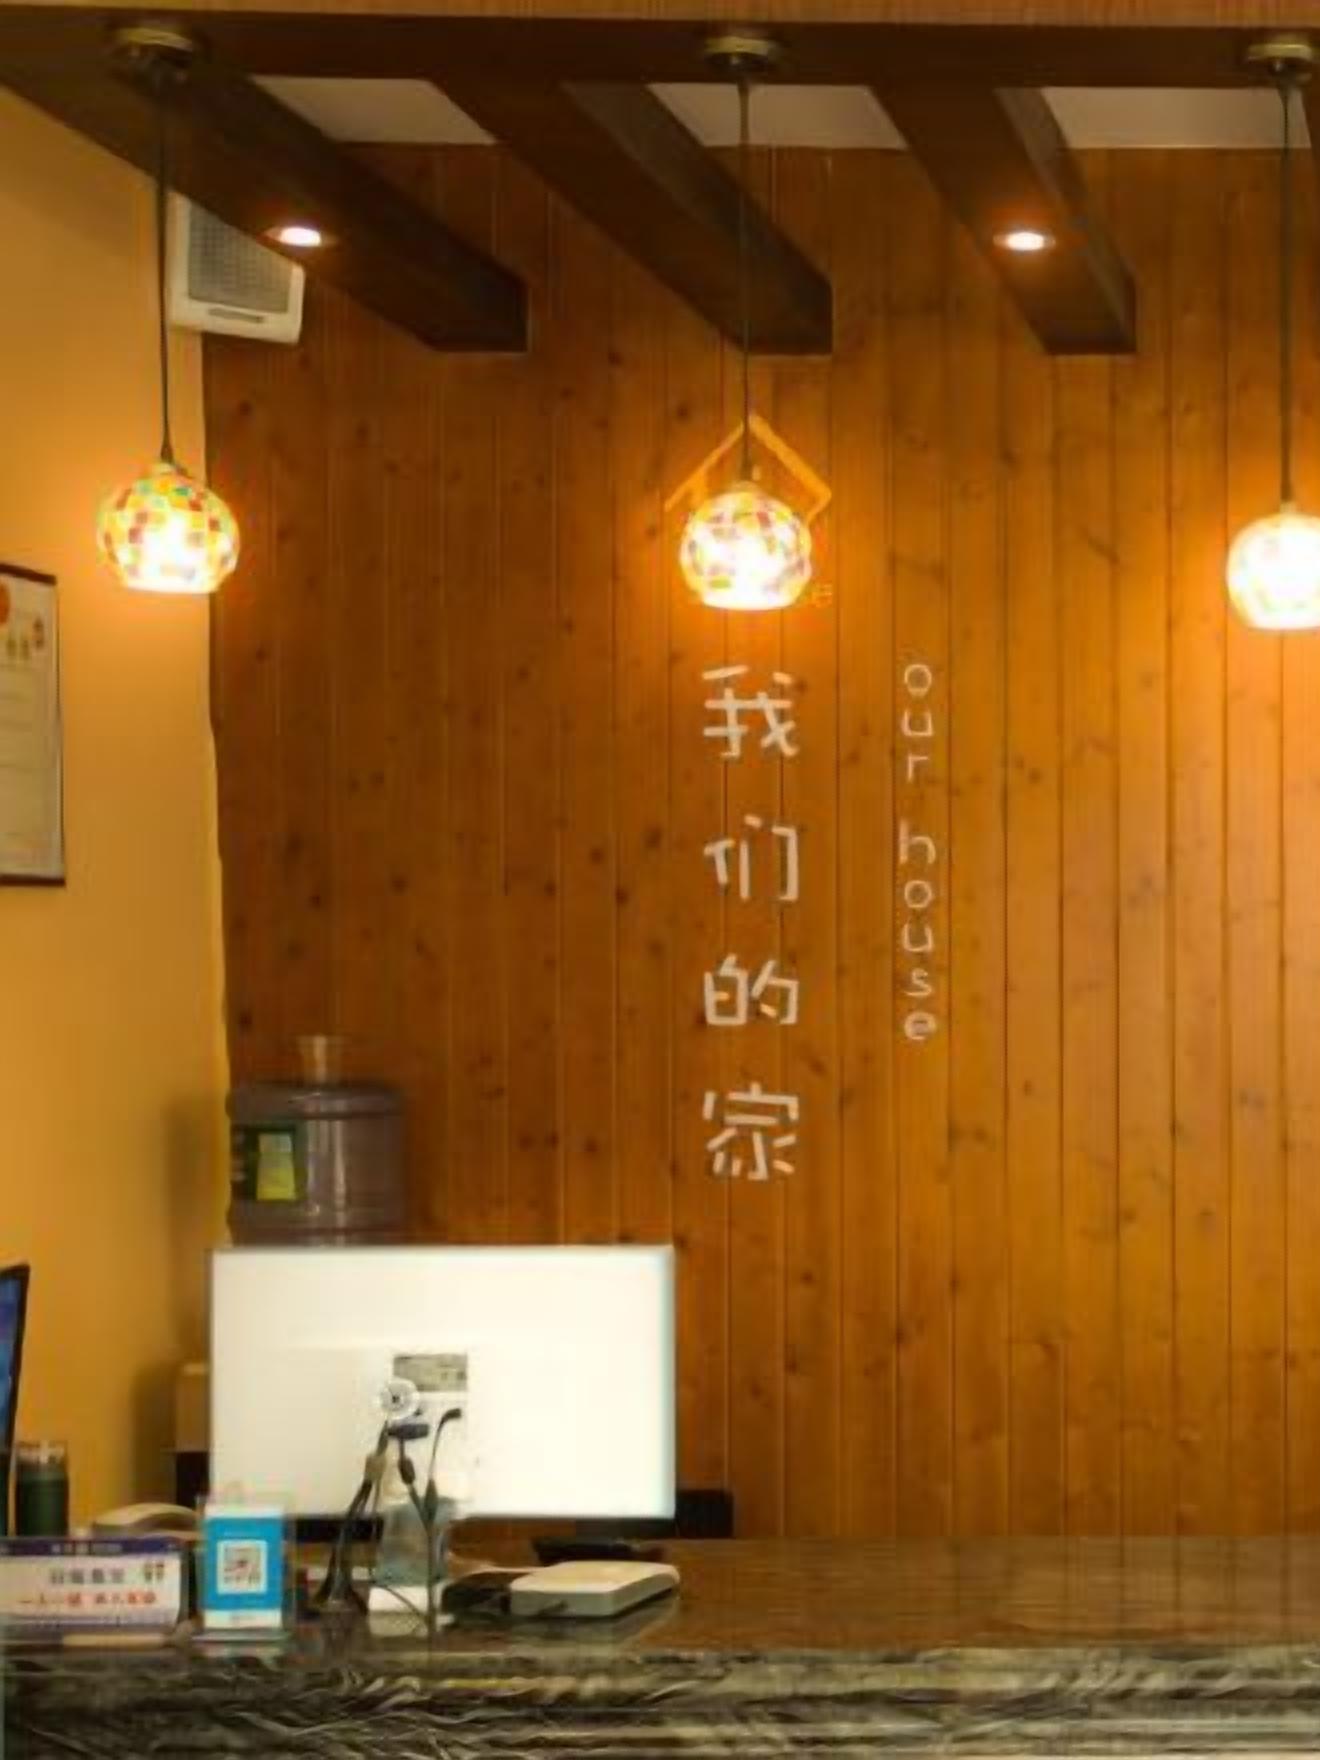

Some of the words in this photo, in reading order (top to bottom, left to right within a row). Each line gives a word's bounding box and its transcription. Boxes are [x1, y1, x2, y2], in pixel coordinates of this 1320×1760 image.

[903, 663, 934, 783] our
[702, 665, 799, 1181] 我们的家
[900, 819, 937, 1041] house
